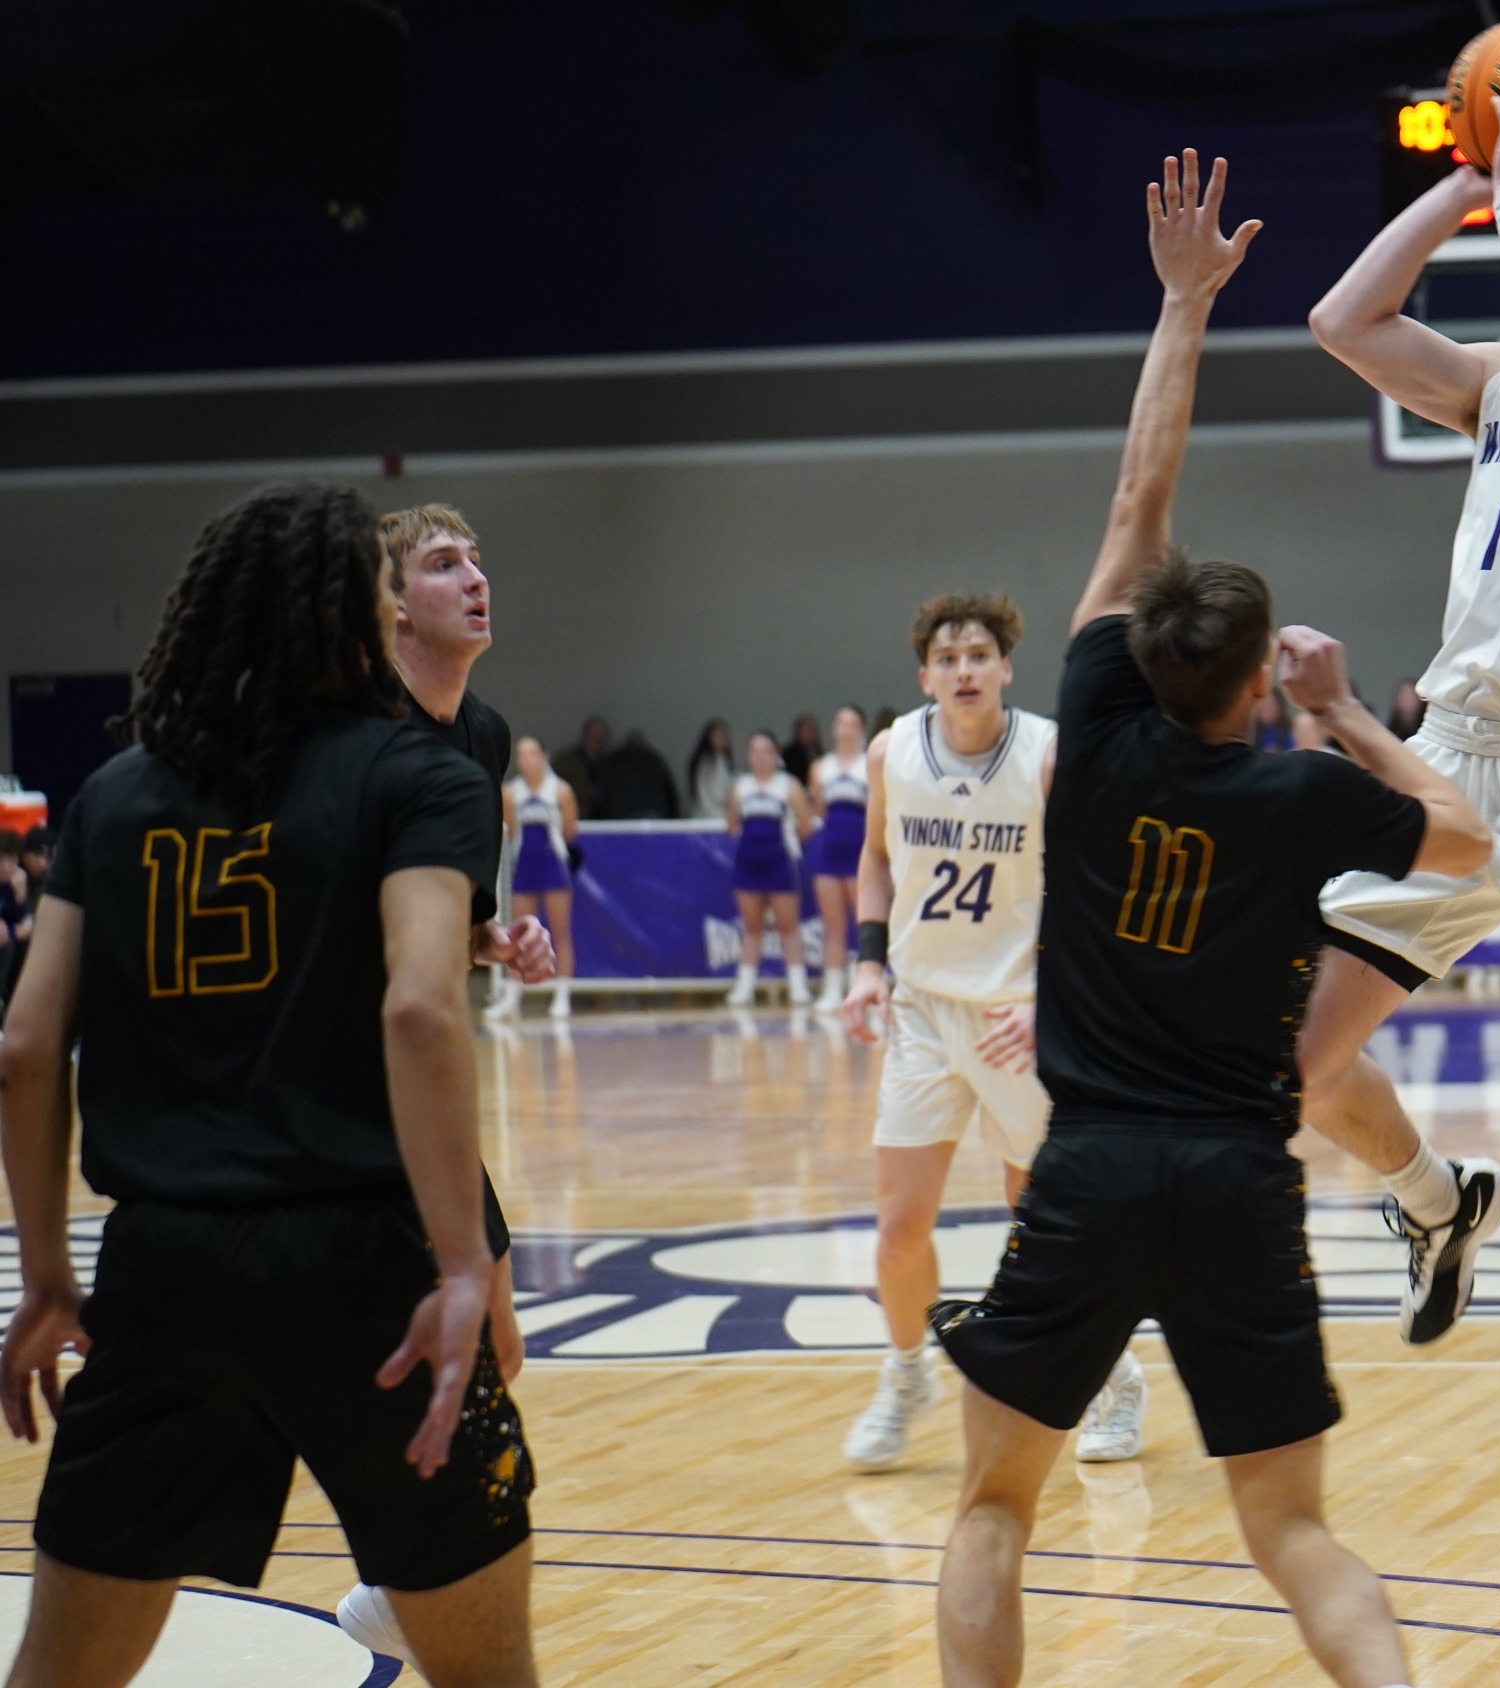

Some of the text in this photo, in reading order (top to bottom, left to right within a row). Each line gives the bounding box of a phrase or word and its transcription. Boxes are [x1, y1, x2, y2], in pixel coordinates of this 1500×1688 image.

[970, 823, 1028, 853] STATE
[1115, 815, 1215, 955] 11
[142, 822, 279, 998] 15
[920, 858, 996, 923] 24
